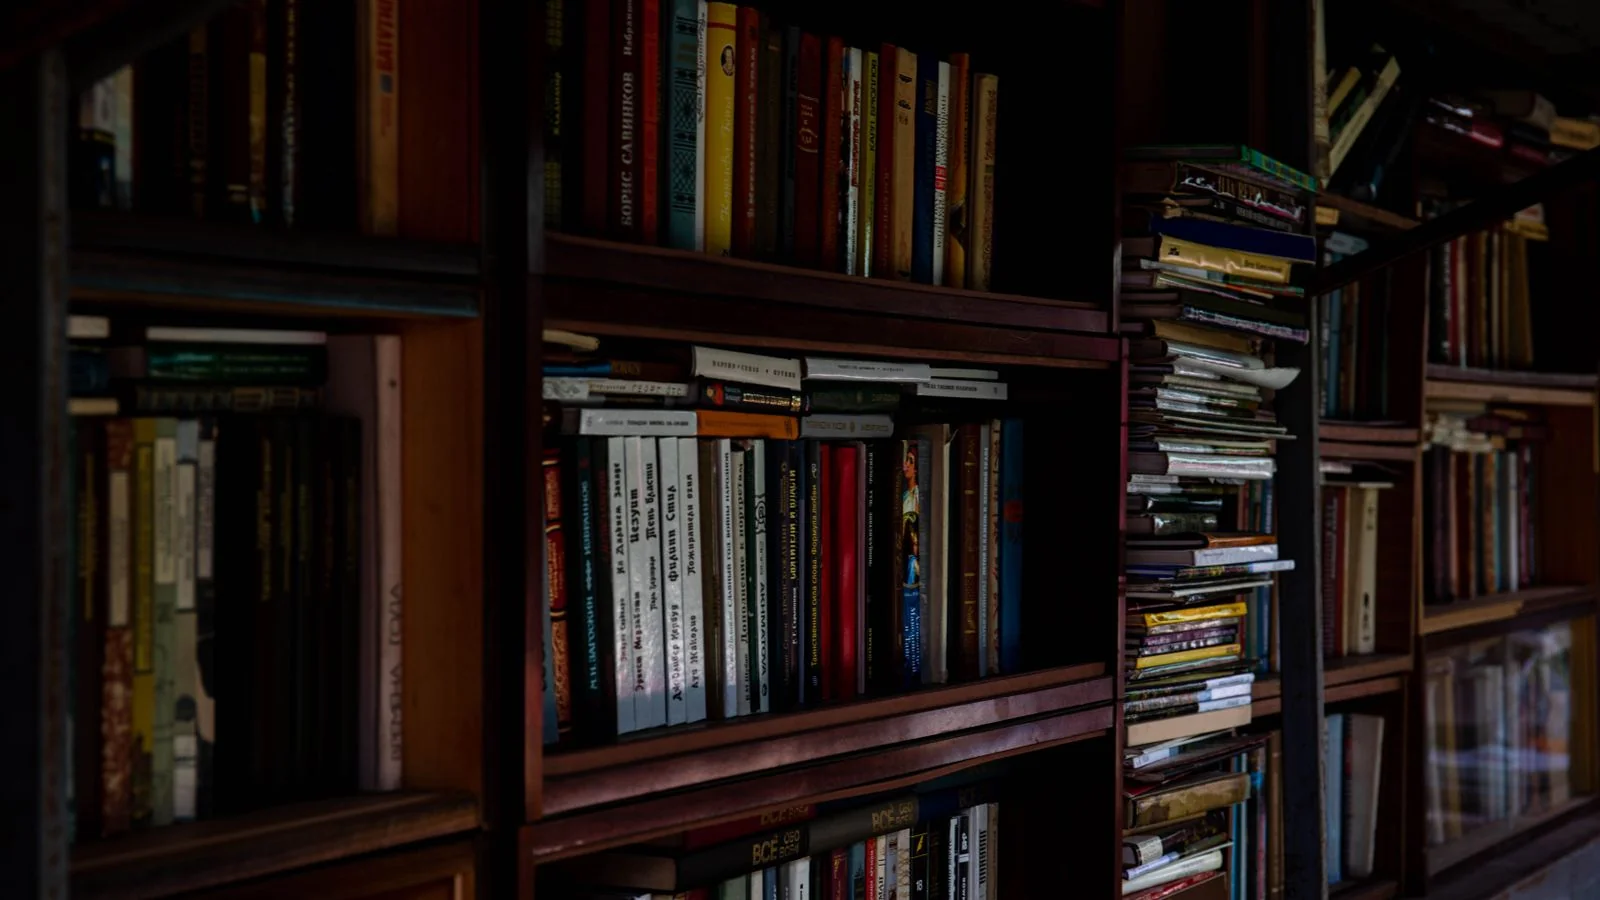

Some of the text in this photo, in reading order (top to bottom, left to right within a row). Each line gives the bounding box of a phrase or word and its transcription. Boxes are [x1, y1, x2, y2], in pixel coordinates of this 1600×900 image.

[621, 71, 637, 166] САВИНКОВ
[620, 170, 635, 227] БОРИС
[580, 481, 592, 556] ИЗБРАННОЕ
[613, 462, 625, 574] На Дальнем Западе
[629, 488, 641, 544] Иезуит
[737, 462, 746, 539] портретам
[788, 469, 798, 509] ВЛАСТИ
[645, 507, 657, 540] Тень
[664, 484, 679, 582] Филипп Стил
[685, 473, 696, 577] Пожиратели огня
[809, 484, 819, 556] Формула любви
[788, 522, 799, 580] СВЯТИТЕЛИ
[725, 563, 734, 608] СЛАВНЫЙ
[739, 556, 750, 644] Дополнение
[810, 587, 818, 606] сила
[688, 614, 698, 665] Жаколио
[809, 608, 819, 667] Таинственная
